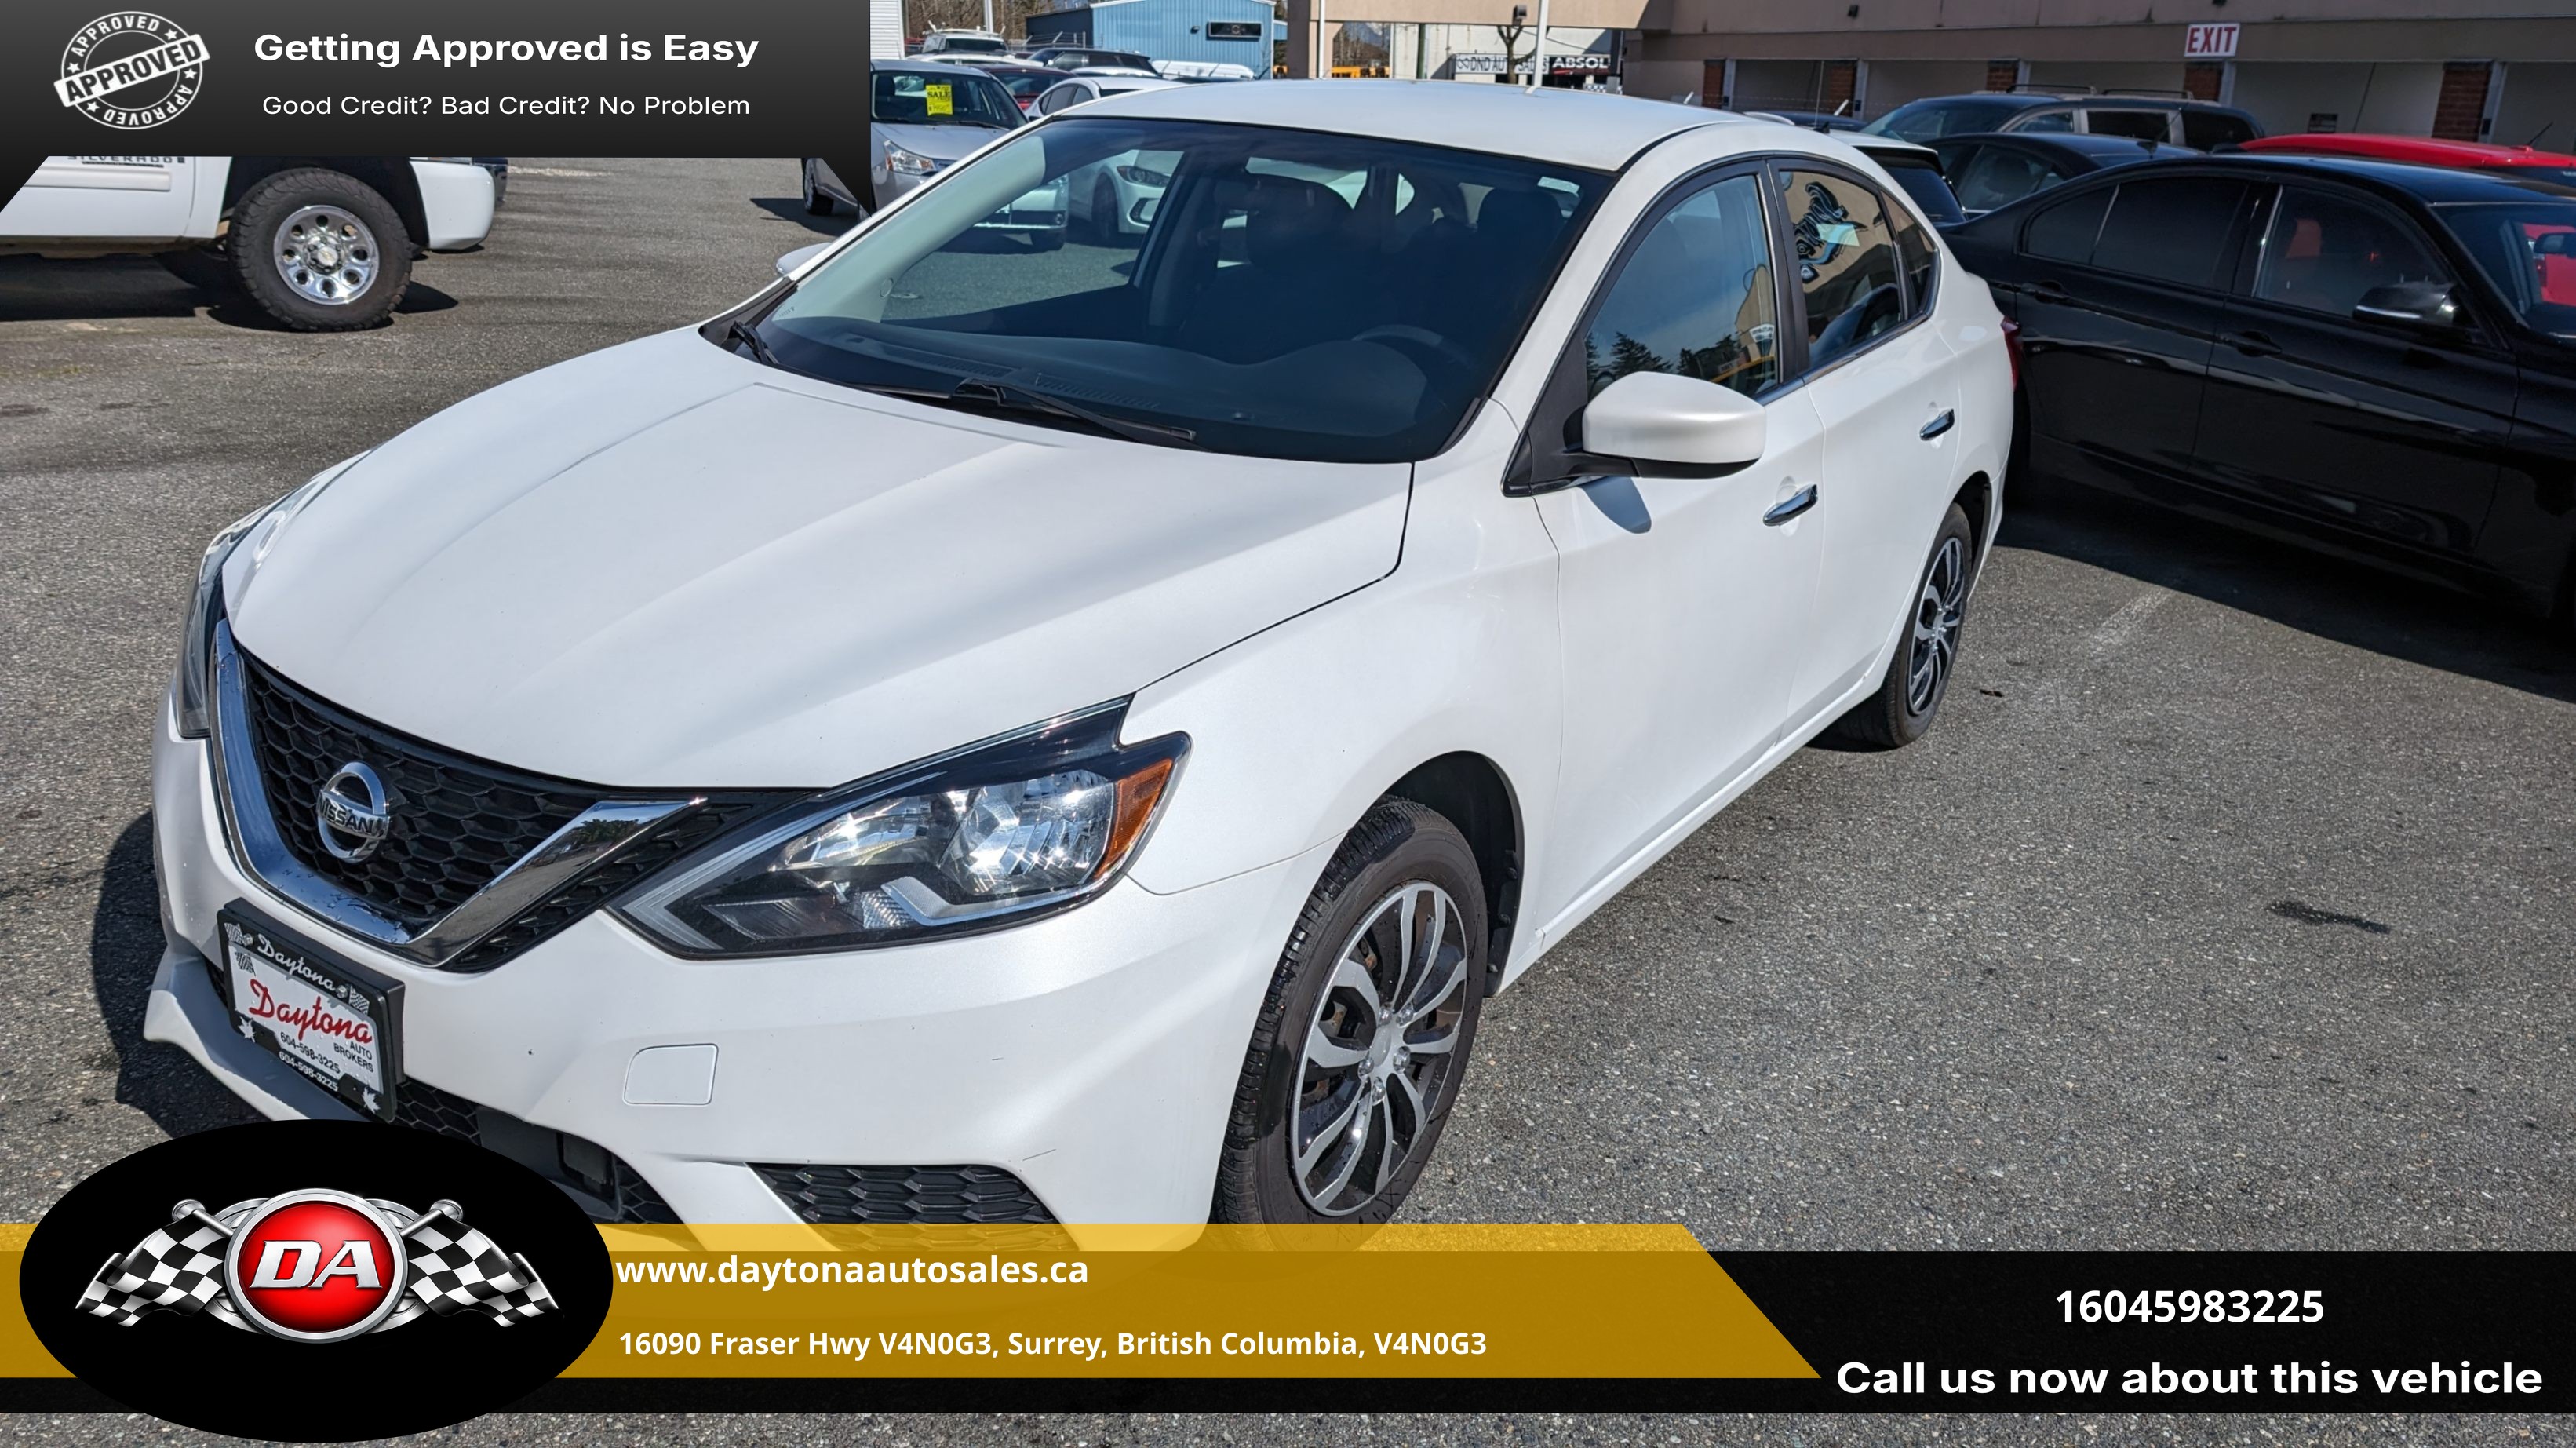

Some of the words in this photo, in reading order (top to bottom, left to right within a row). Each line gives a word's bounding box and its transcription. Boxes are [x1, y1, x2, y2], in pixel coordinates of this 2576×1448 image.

[2187, 27, 2237, 53] EXIT
[319, 792, 373, 834] NISSAN
[257, 933, 336, 993] Daytona
[249, 979, 373, 1044] Daytona
[280, 1031, 341, 1074] 604-598-3225
[333, 1042, 374, 1073] BROKERS
[350, 1041, 373, 1060] AUTO
[279, 1051, 338, 1092] 604-598-3225
